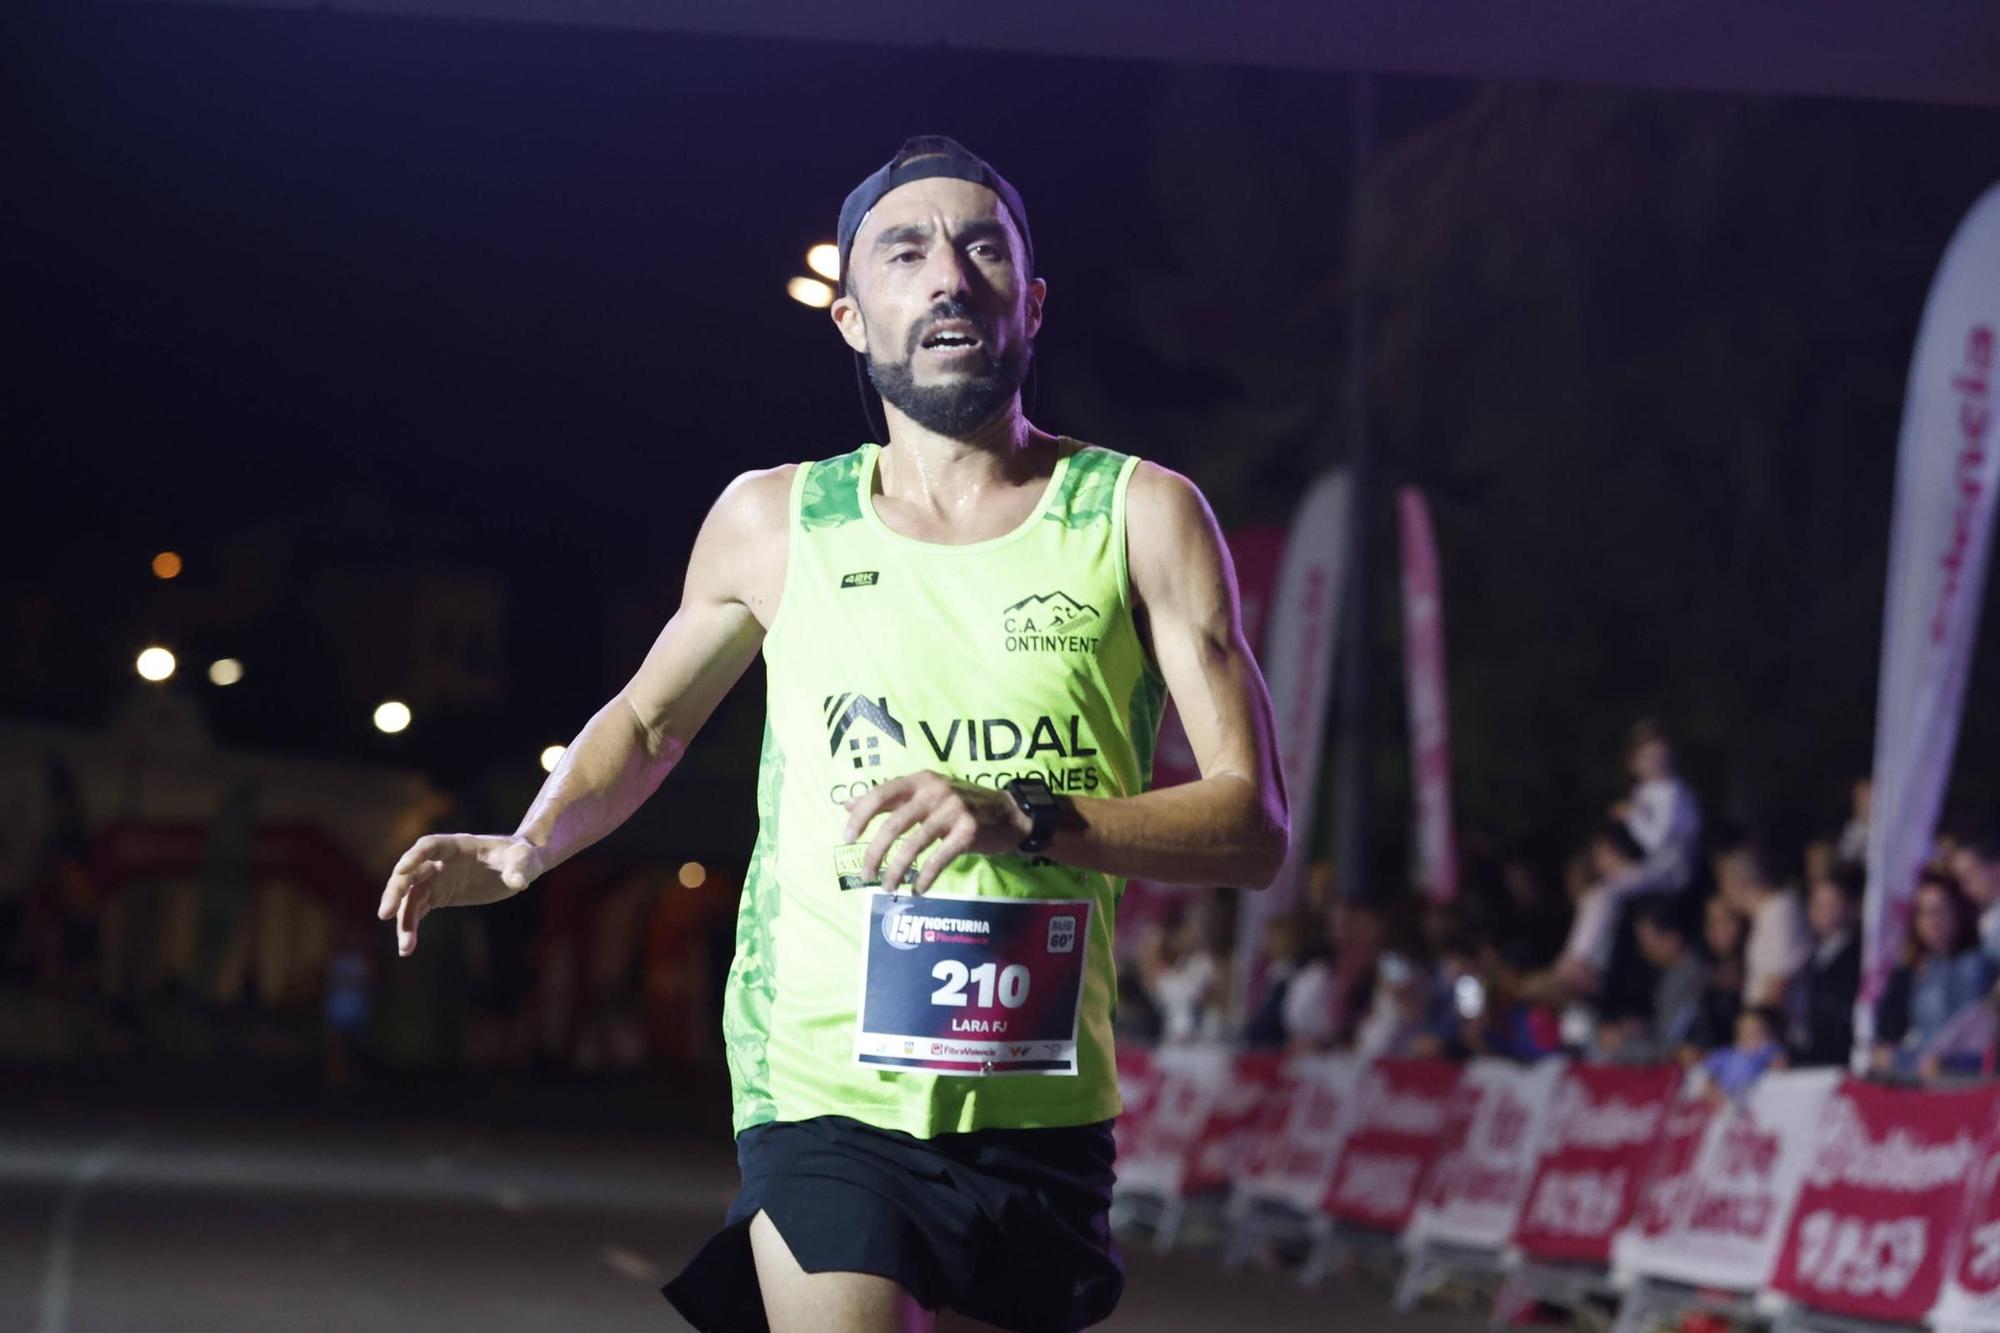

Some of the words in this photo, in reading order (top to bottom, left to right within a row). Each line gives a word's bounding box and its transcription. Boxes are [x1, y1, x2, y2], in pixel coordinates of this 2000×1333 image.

[1004, 617, 1042, 633] C.A.
[1005, 635, 1099, 654] ONTINYENT
[918, 715, 1097, 762] VIDAL
[922, 916, 990, 934] NOCTURNA
[931, 959, 1031, 1009] 210
[952, 1019, 989, 1032] LARA
[993, 1021, 1008, 1033] FJ
